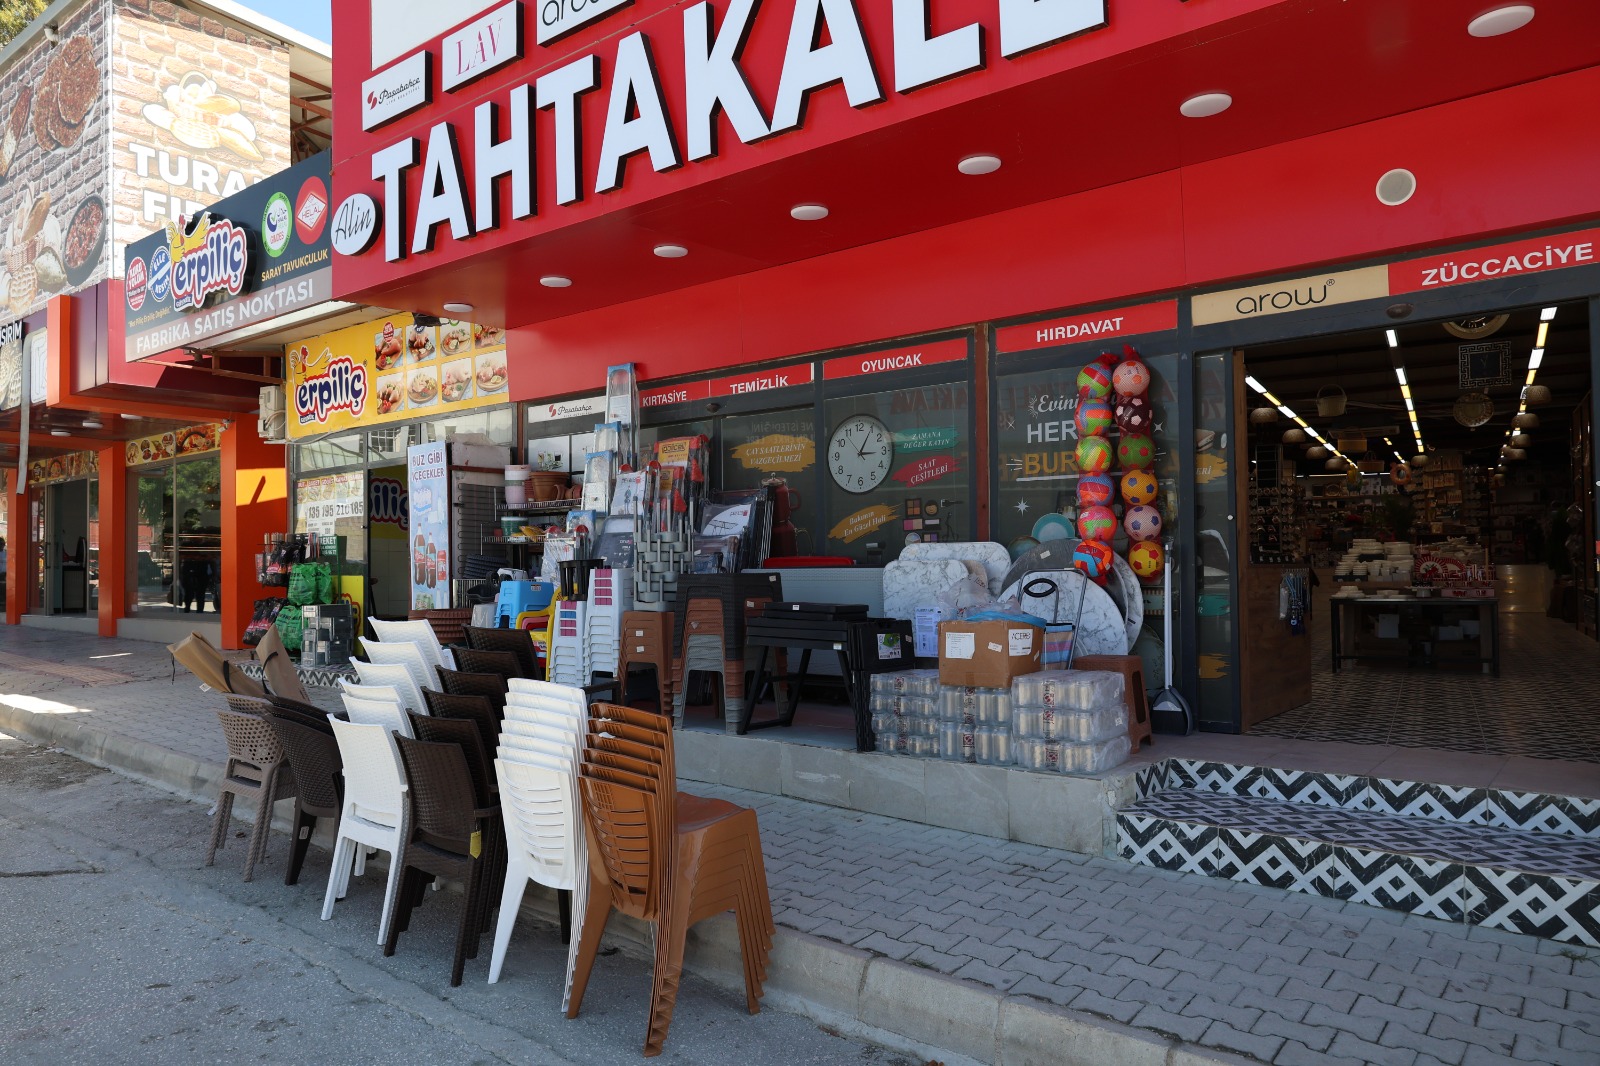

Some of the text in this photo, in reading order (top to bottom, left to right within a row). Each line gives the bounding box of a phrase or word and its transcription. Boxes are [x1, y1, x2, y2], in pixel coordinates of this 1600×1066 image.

[455, 18, 502, 76] LAV
[128, 142, 262, 198] TURA
[335, 198, 372, 245] Alin
[175, 231, 242, 296] erpiliç
[261, 248, 328, 282] SARAY TAVUKÇULUK
[1421, 243, 1593, 287] ZÜCCACİYE
[194, 305, 235, 335] SATIŞ
[239, 278, 313, 320] NOKTASI
[1036, 317, 1123, 342] HIRDAVAT
[861, 353, 922, 373] OYUNCAK
[298, 365, 363, 415] erpiliç
[730, 376, 788, 395] TEMİZLİK
[642, 390, 687, 407] KIRTASİYE
[845, 428, 852, 437] 11
[855, 423, 864, 432] 12
[876, 433, 882, 442] 2
[911, 431, 941, 440] ZAMANA
[837, 438, 846, 447] 10
[903, 438, 950, 449] DEĞER KATIN
[834, 452, 840, 461] 9
[881, 446, 887, 455] 3
[412, 454, 425, 467] BUZ
[878, 460, 883, 469] 4
[918, 459, 937, 471] SAAT
[838, 465, 844, 475] 8
[870, 472, 876, 481] 5
[847, 475, 852, 483] 7
[857, 477, 864, 486] 6
[308, 506, 320, 519] 135
[322, 504, 334, 518] 195
